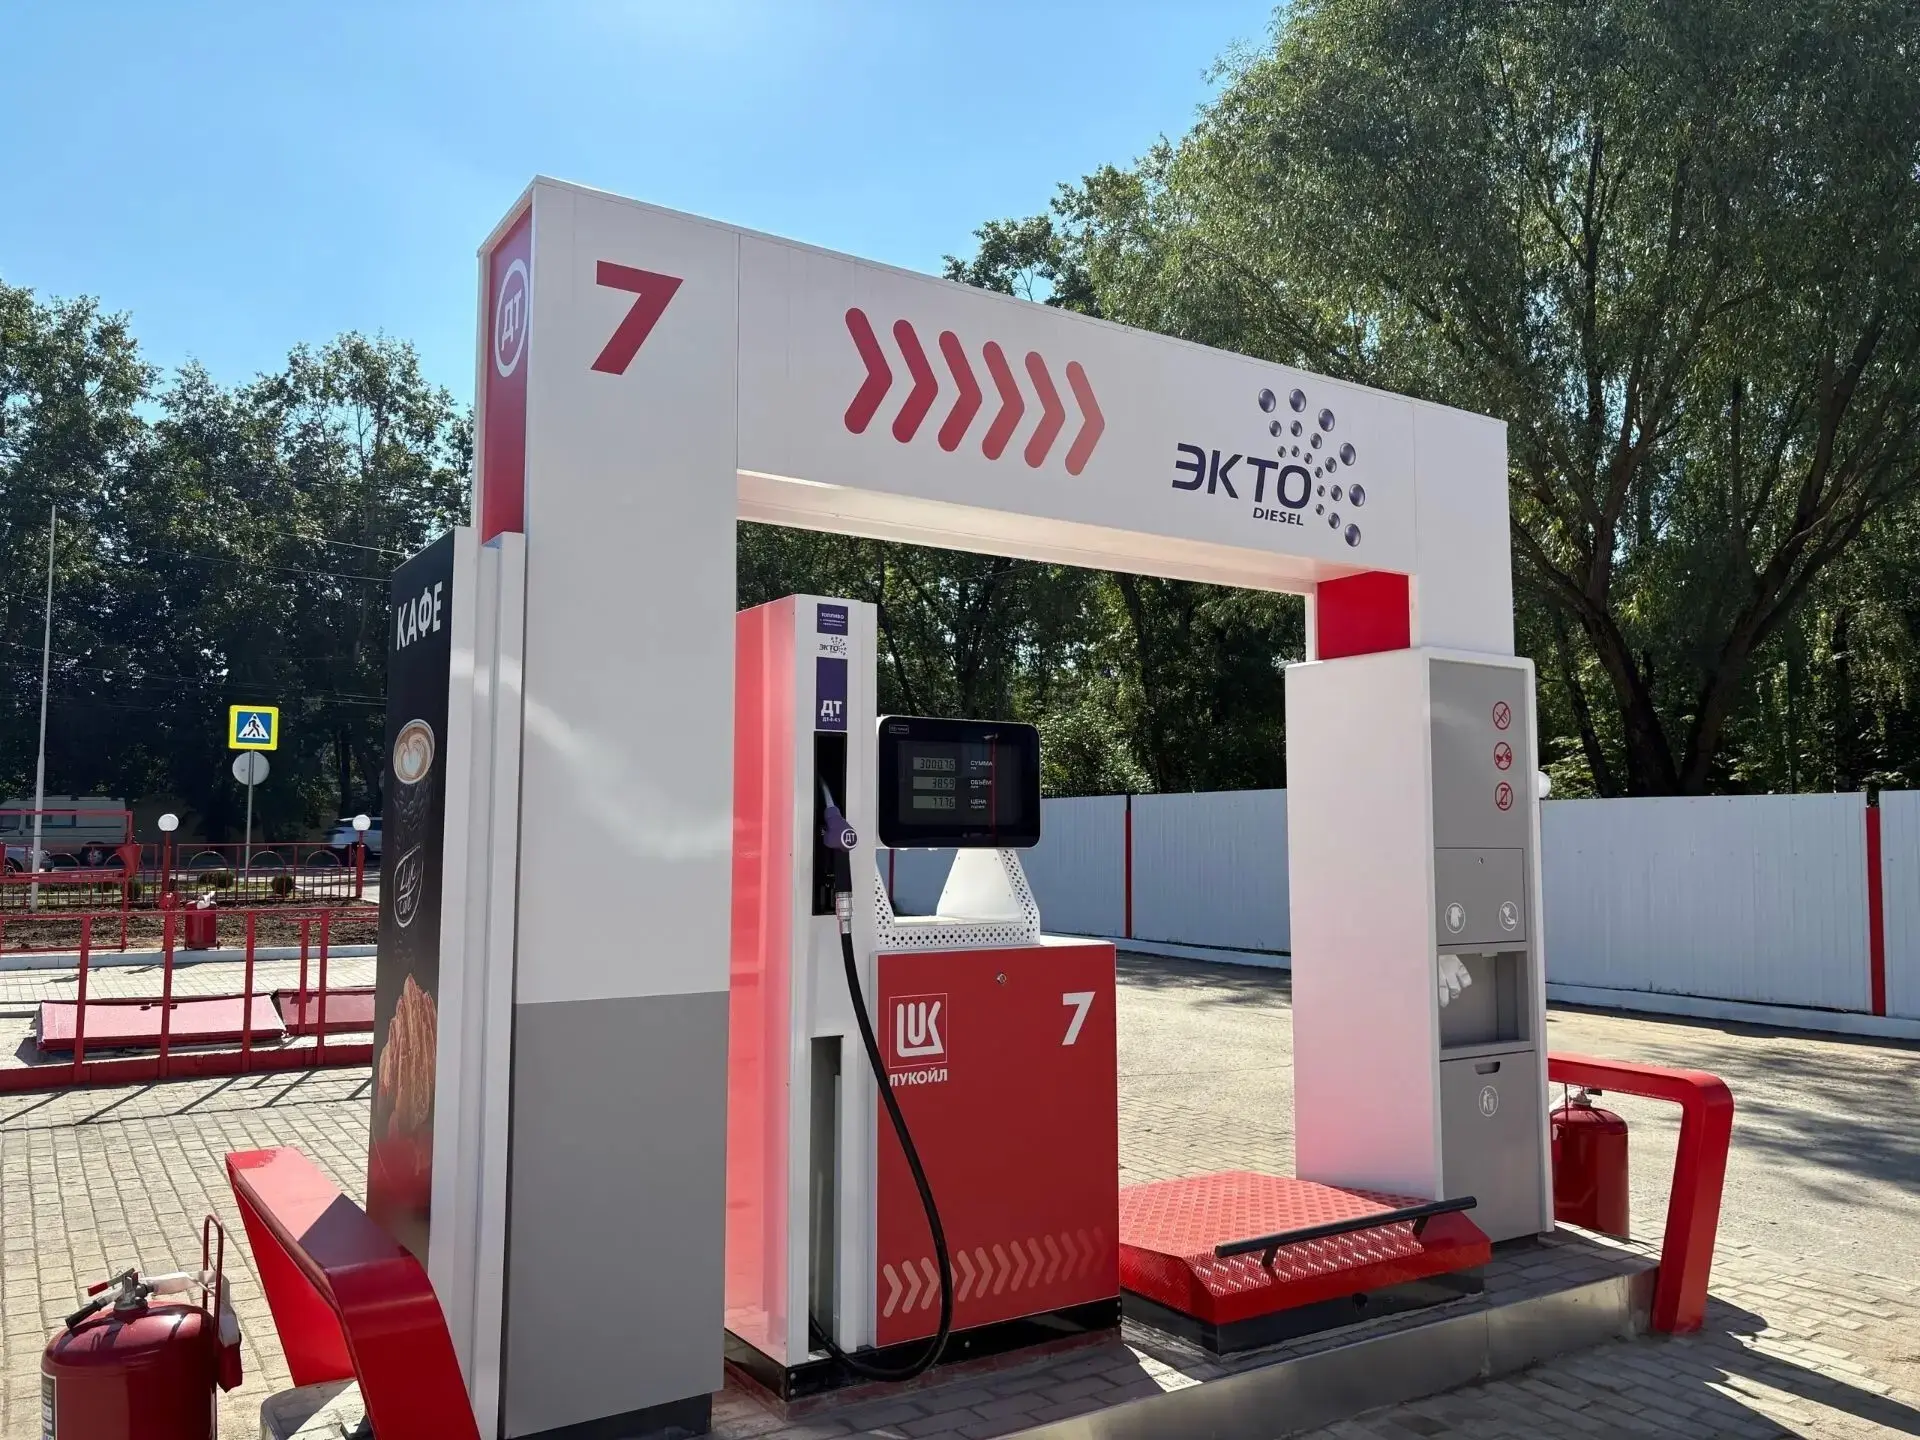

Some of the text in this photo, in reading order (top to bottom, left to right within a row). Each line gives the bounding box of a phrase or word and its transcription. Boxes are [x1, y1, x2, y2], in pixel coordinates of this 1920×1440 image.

[501, 288, 522, 351] ДТ
[590, 259, 684, 376] 7
[1172, 442, 1312, 509] ЭКТО
[1252, 507, 1304, 526] DIESEL
[396, 580, 443, 651] КАФЕ
[819, 643, 839, 652] ЭКТО
[820, 700, 842, 717] ДТ
[845, 832, 855, 843] ДТ
[1061, 991, 1096, 1046] 7
[889, 1067, 948, 1087] ЛУКОЙЛ
